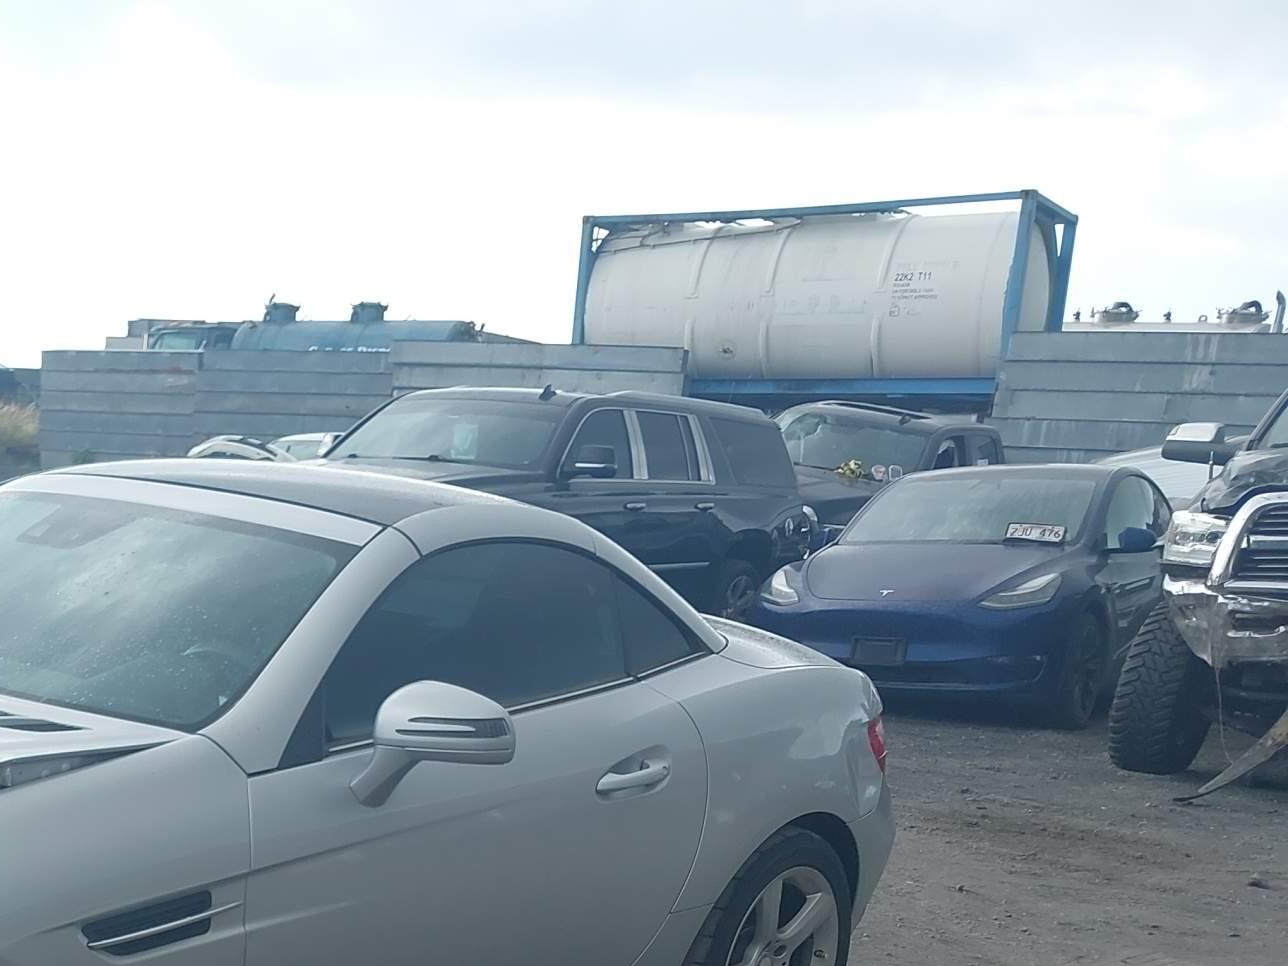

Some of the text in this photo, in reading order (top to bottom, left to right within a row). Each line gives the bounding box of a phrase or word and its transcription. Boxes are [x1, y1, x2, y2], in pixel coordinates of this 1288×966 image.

[894, 271, 932, 281] 22K2 T11
[1039, 528, 1061, 539] 476
